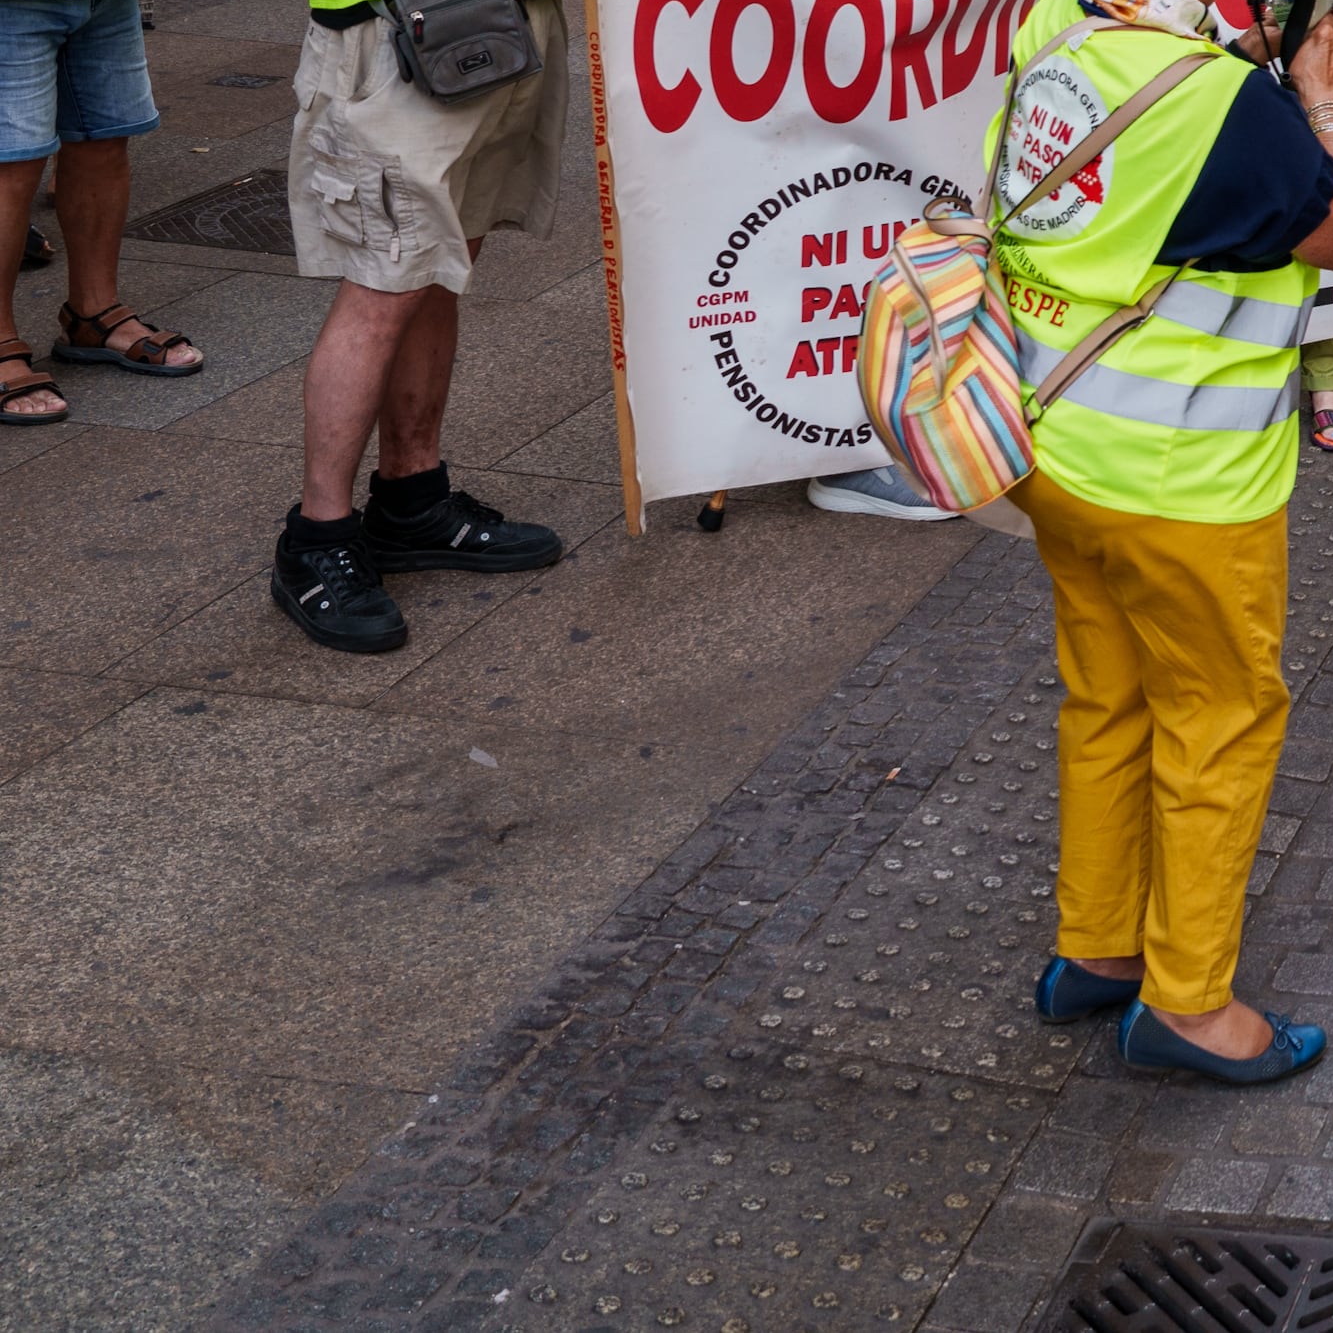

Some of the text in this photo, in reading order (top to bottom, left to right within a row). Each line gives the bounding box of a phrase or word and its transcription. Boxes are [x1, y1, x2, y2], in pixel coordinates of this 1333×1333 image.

[1029, 105, 1049, 130] NI
[1050, 120, 1073, 146] UN
[1023, 136, 1064, 168] PASO
[708, 161, 914, 288] COORDINADORA
[1049, 195, 1087, 230] MADRID
[801, 229, 848, 268] NI
[696, 290, 749, 307] CGPM
[688, 310, 757, 329] UNIDAD
[710, 330, 873, 448] PENSIONISTAS
